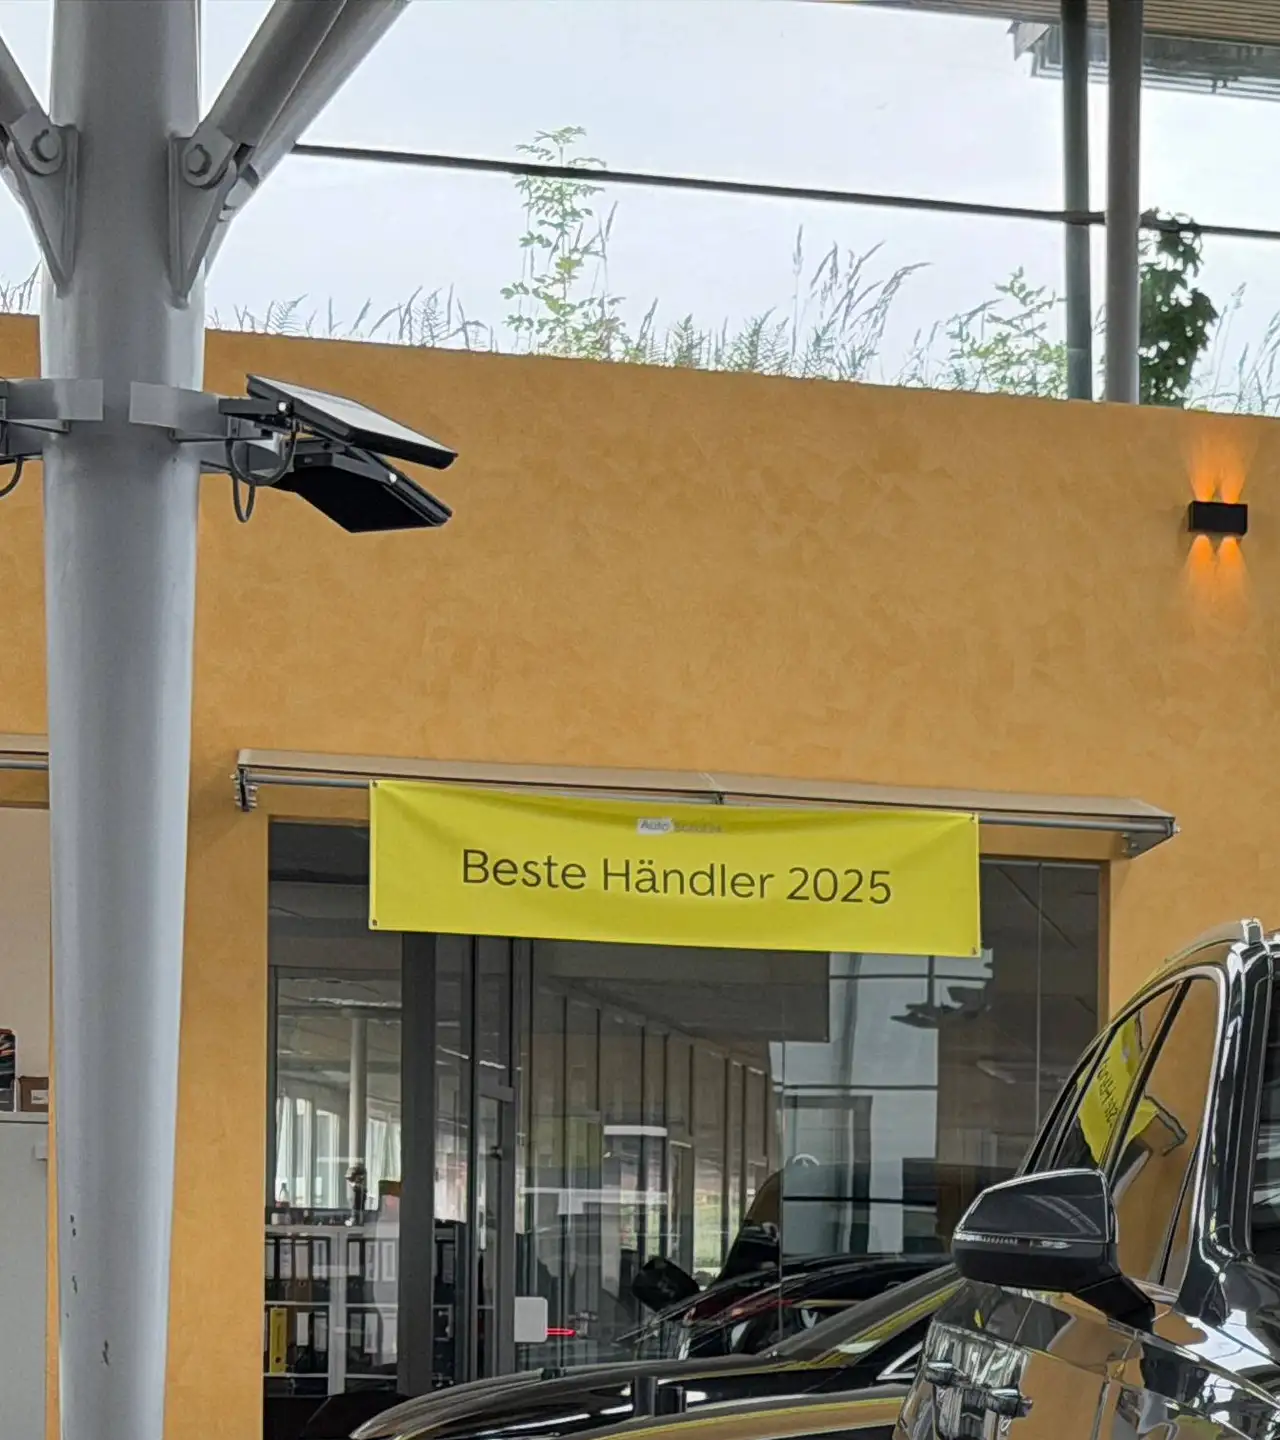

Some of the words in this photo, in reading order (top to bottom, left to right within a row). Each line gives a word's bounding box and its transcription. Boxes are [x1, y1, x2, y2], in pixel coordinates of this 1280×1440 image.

[462, 848, 586, 890] Beste
[602, 857, 776, 899] Händler
[786, 866, 892, 904] 2025
